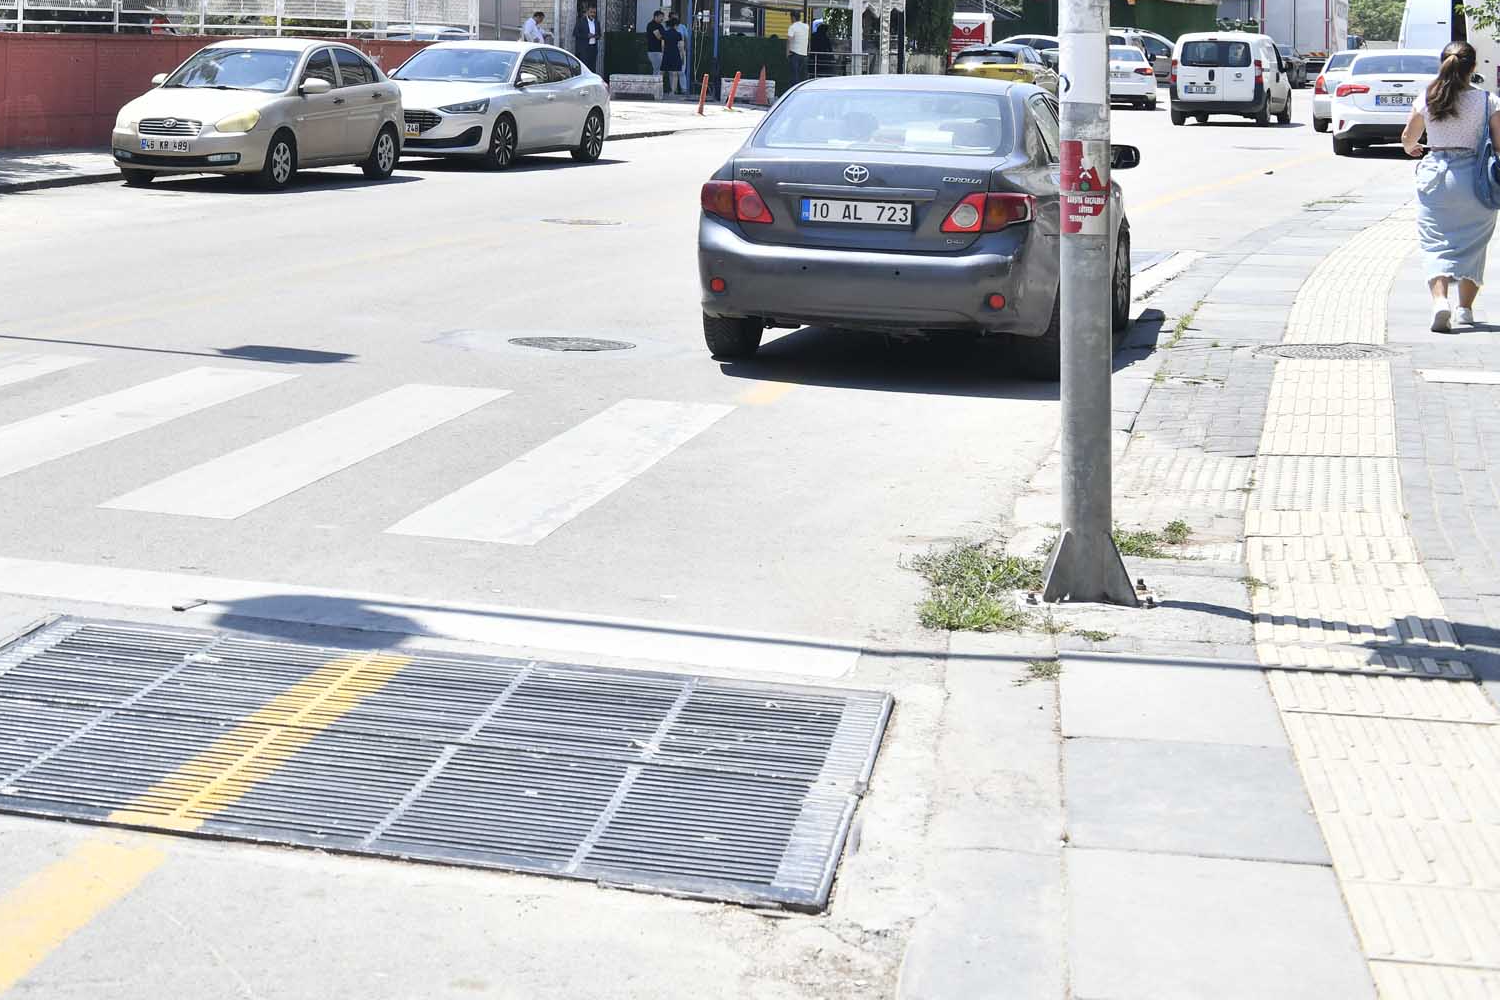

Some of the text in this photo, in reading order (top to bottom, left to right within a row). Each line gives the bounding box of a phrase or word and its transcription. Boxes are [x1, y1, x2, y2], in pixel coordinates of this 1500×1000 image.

[812, 202, 909, 223] 10 AL 723
